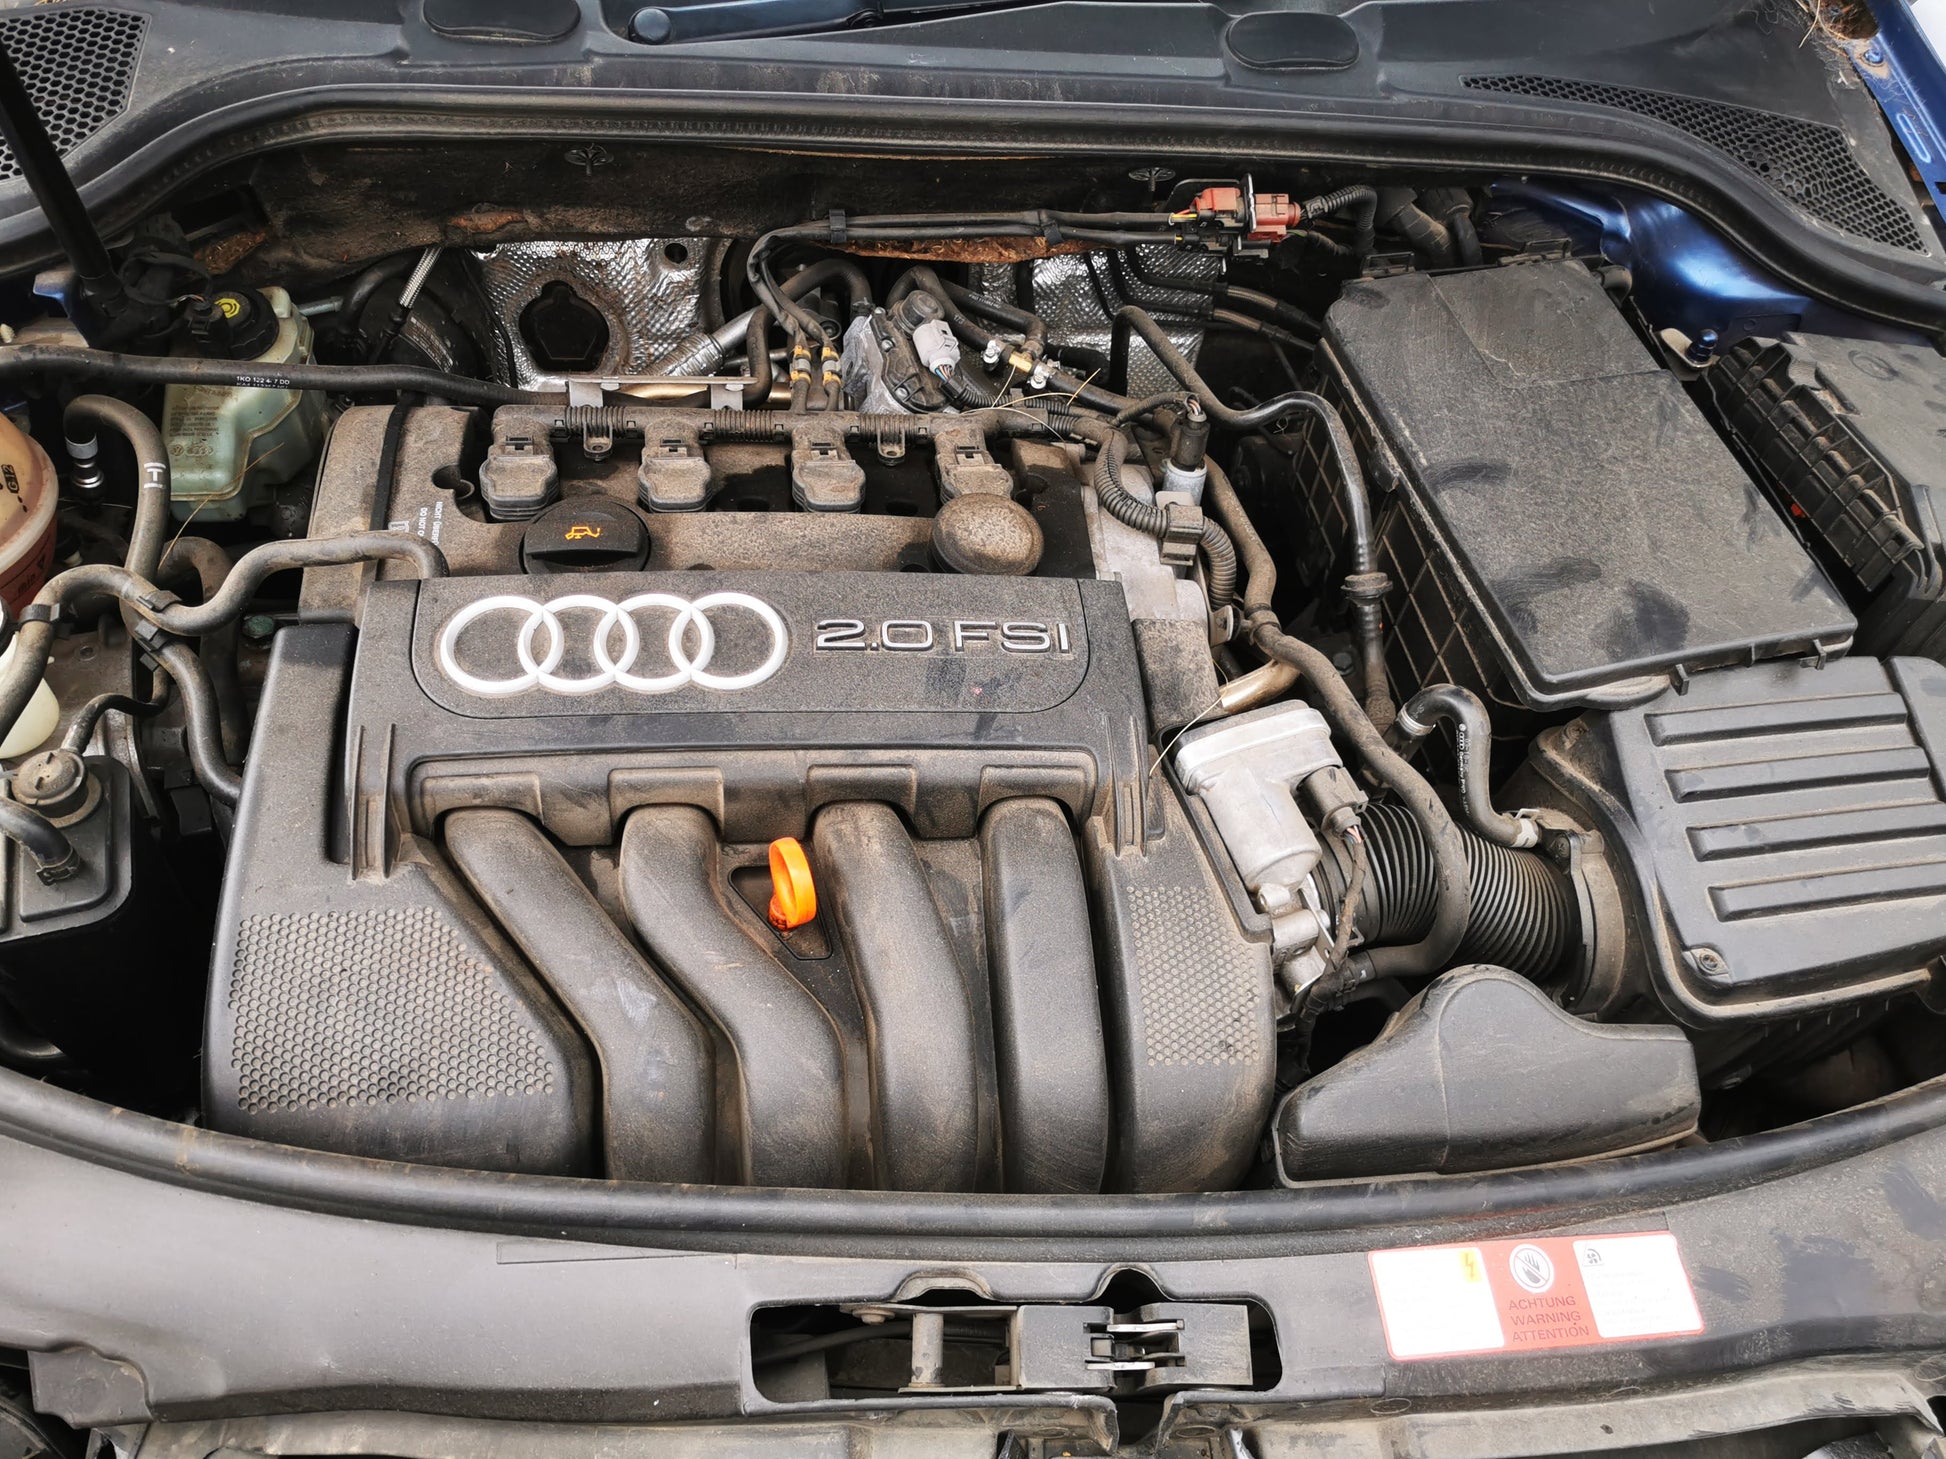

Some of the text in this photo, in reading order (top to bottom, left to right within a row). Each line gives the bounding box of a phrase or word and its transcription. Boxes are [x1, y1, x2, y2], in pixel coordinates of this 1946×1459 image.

[3, 464, 18, 492] G12
[420, 507, 428, 517] DO
[418, 517, 427, 530] NOT
[815, 618, 1072, 654] 2.0 FSI
[1508, 1296, 1576, 1311] ACHTUNG
[1510, 1310, 1581, 1326] WARNING
[1512, 1326, 1590, 1342] ATTENTION
